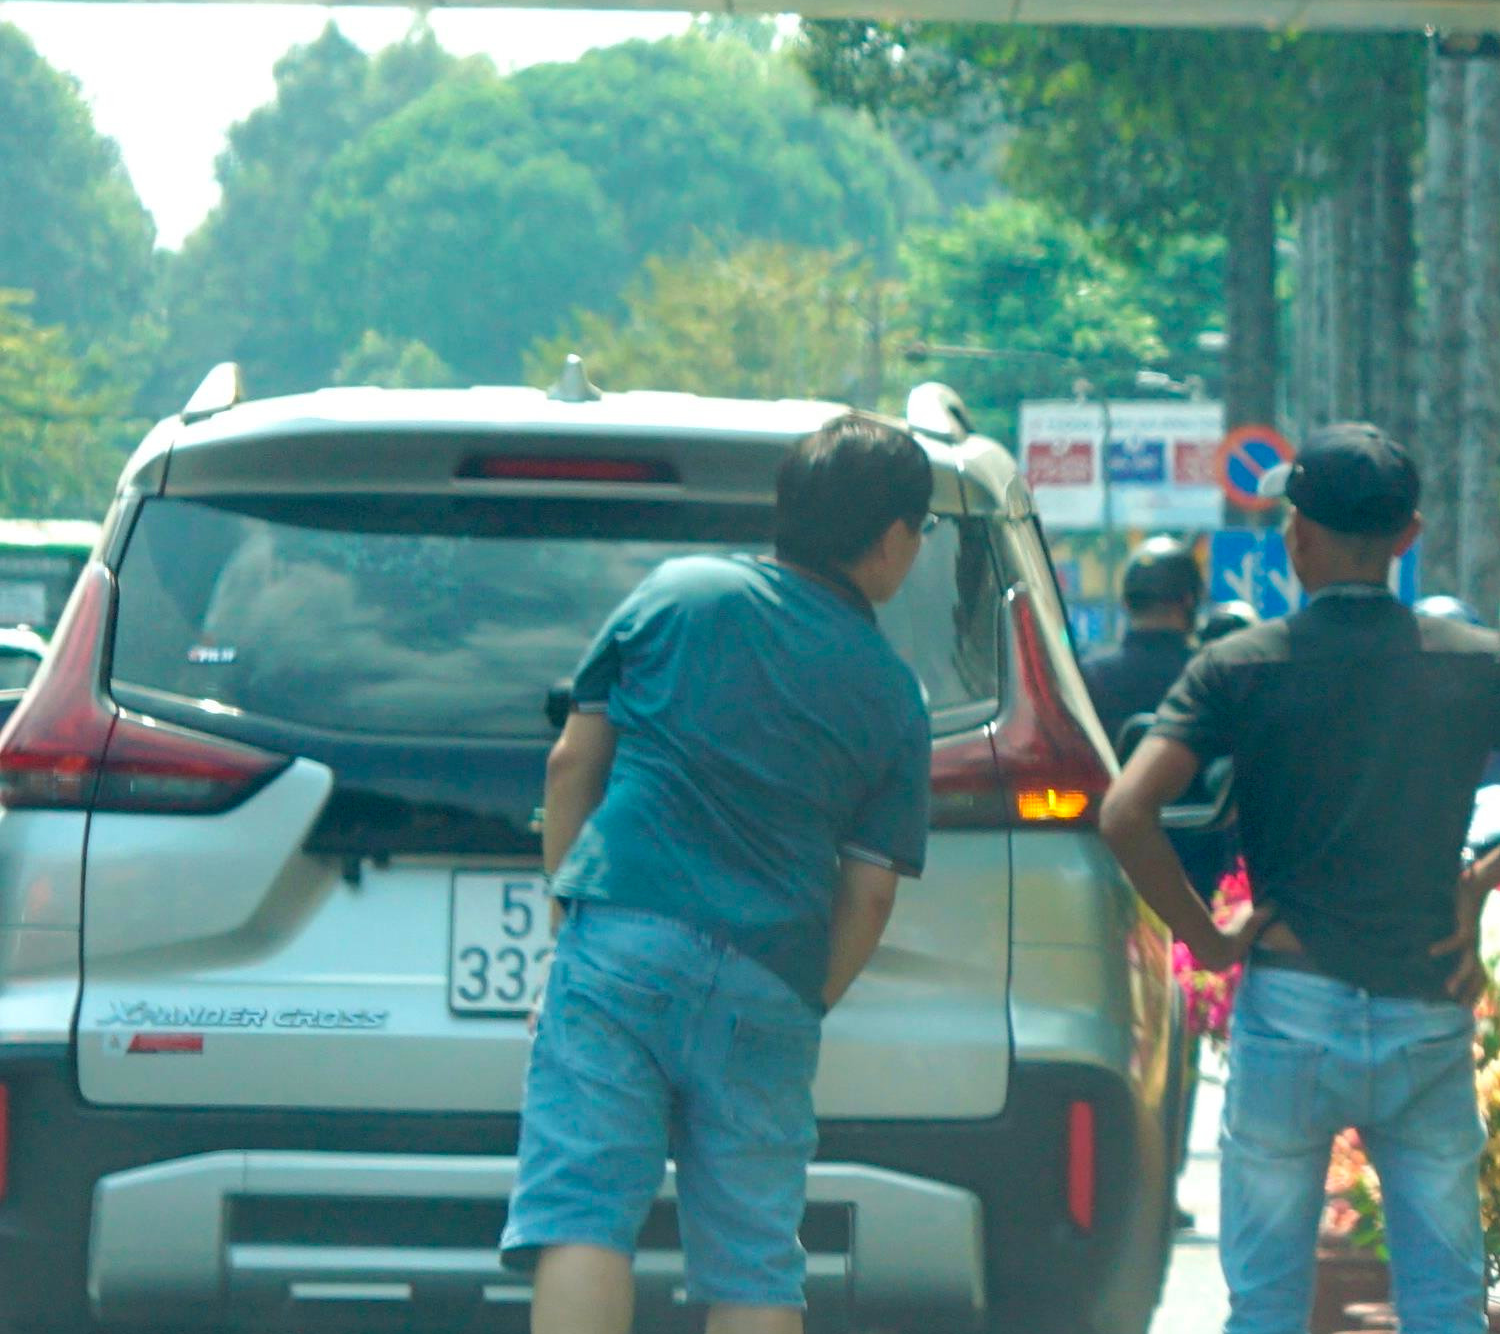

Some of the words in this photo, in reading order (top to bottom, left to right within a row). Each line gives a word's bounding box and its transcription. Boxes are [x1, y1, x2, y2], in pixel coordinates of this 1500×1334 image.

[501, 880, 534, 940] 5
[457, 944, 554, 1004] 33
[274, 1007, 391, 1028] CROSS
